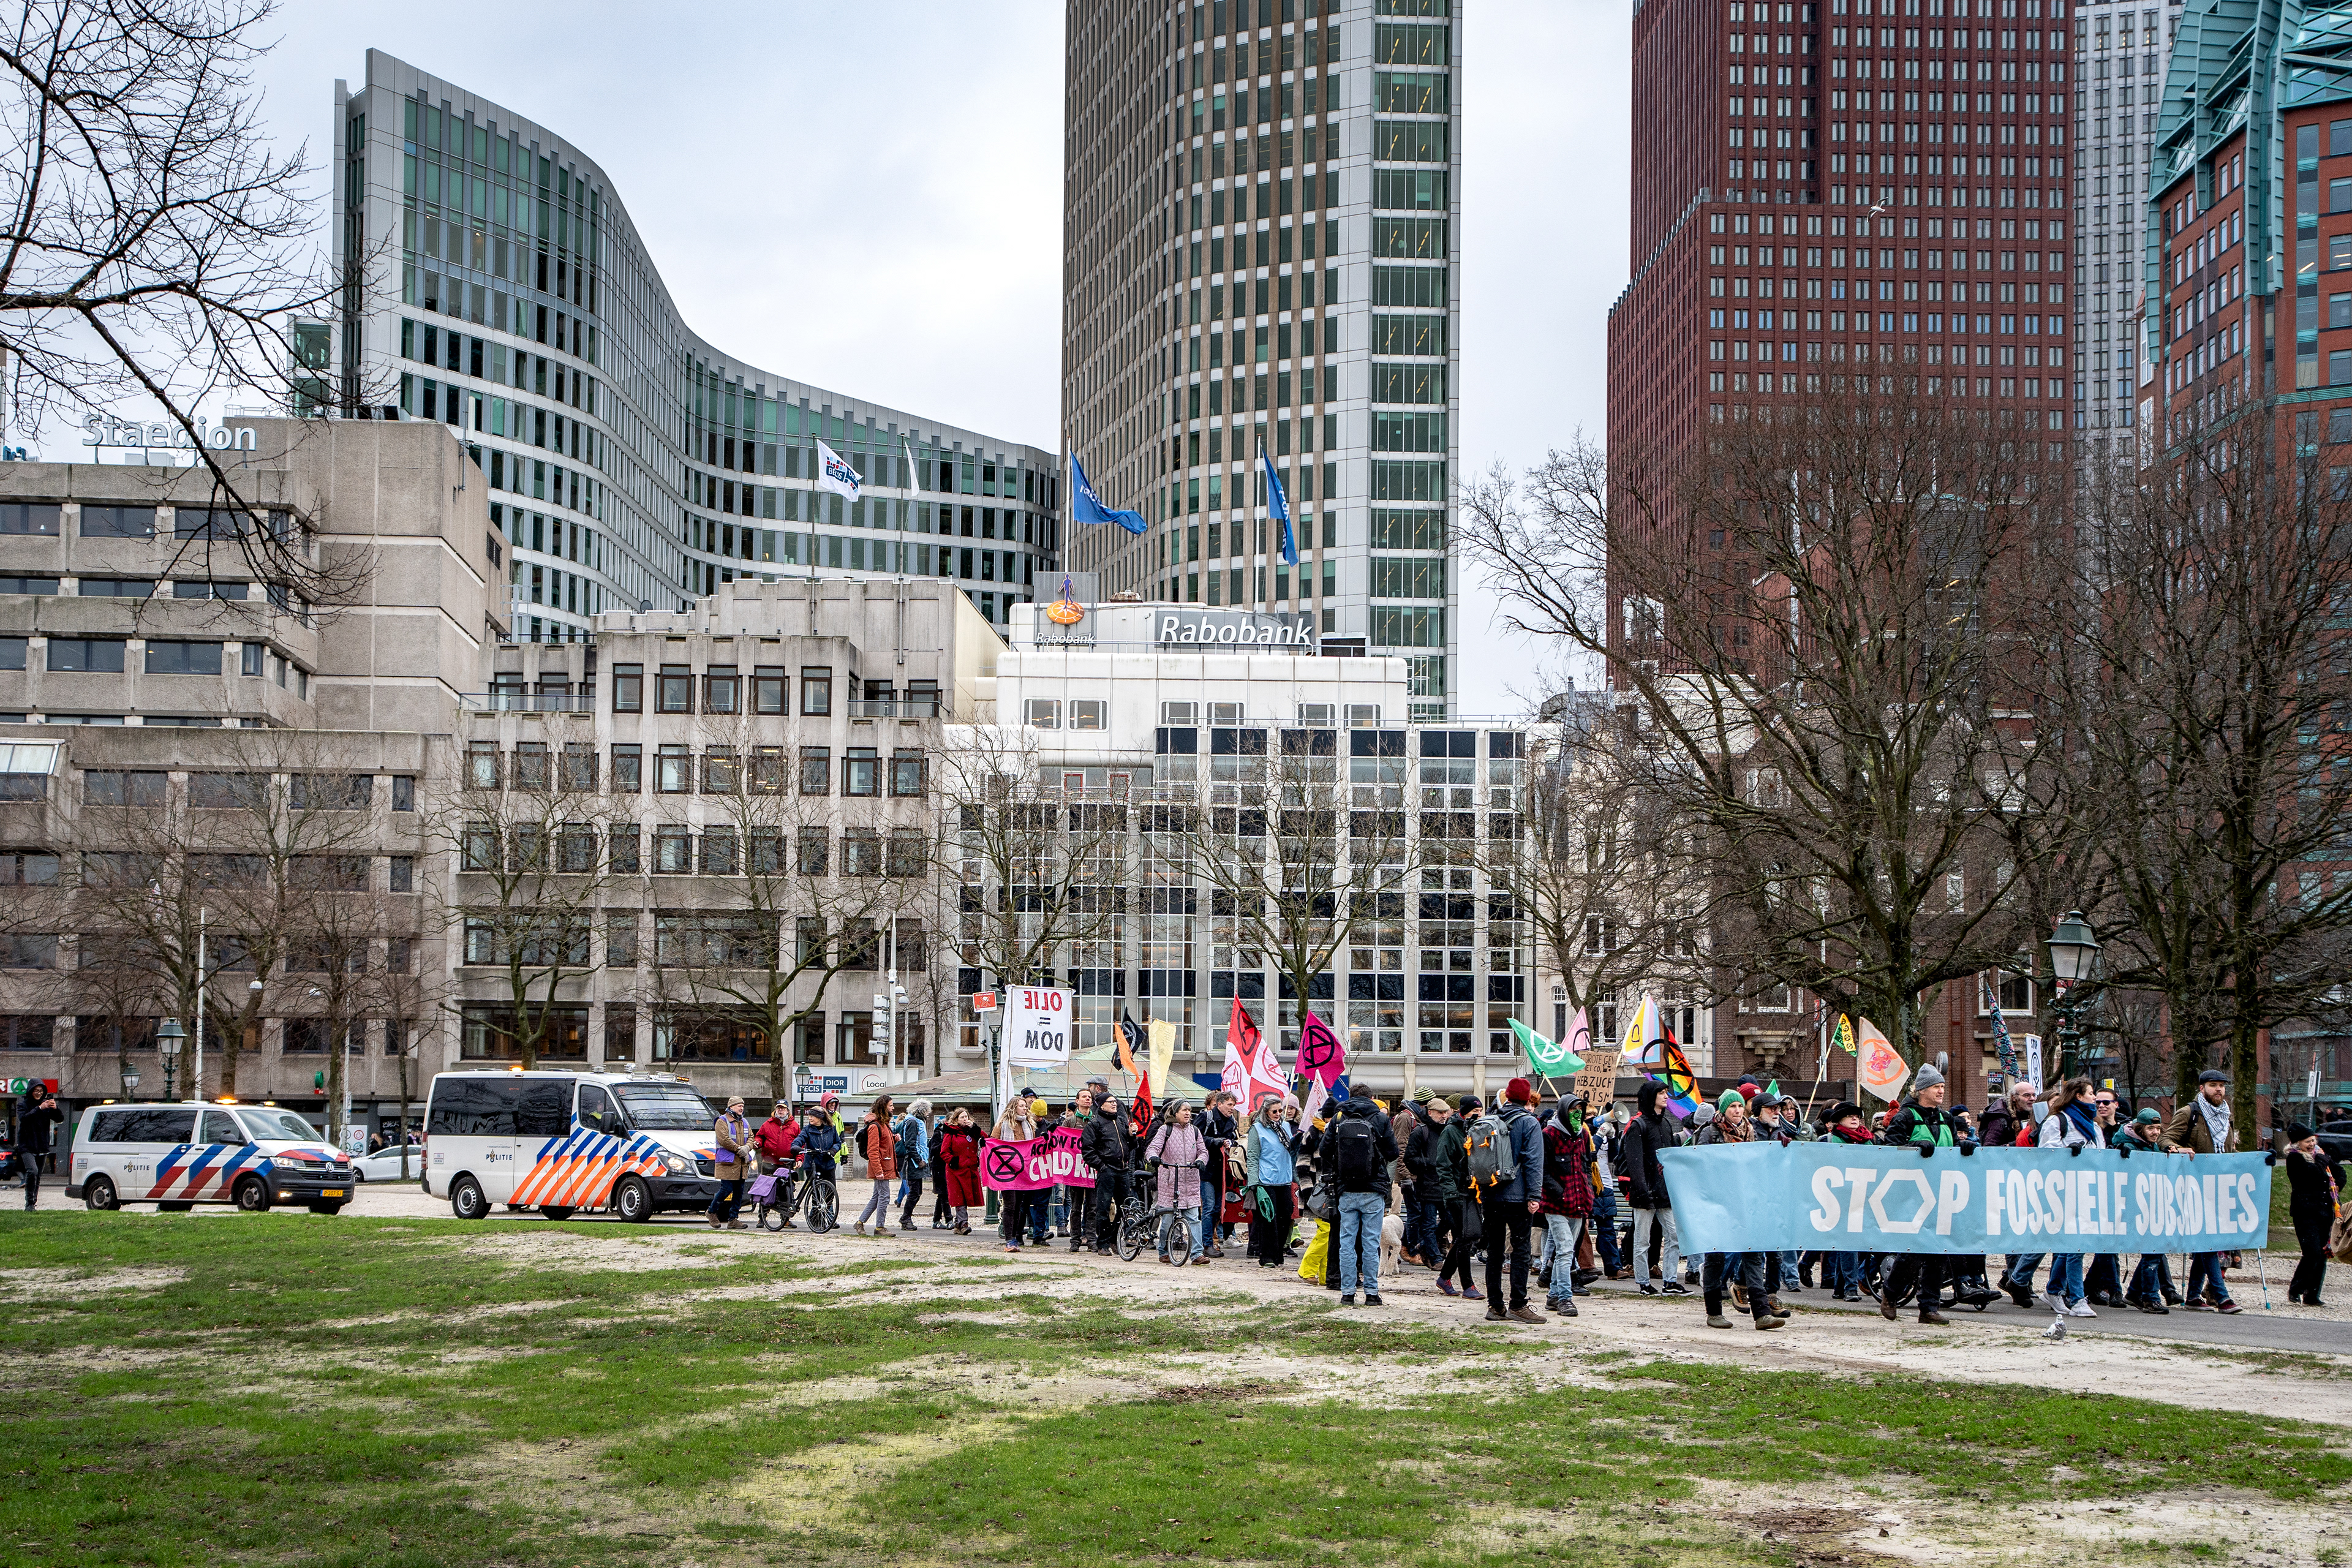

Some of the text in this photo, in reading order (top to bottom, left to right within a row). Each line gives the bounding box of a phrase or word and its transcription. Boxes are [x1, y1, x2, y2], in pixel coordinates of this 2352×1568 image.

[82, 414, 257, 451] Staedion
[828, 468, 843, 480] BECIS
[1036, 632, 1096, 644] Rabobank
[1159, 616, 1313, 644] Rabobank
[486, 1154, 513, 1163] POLITIE
[1810, 1166, 2260, 1236] STOP FOSSIELE SUBSIDIES
